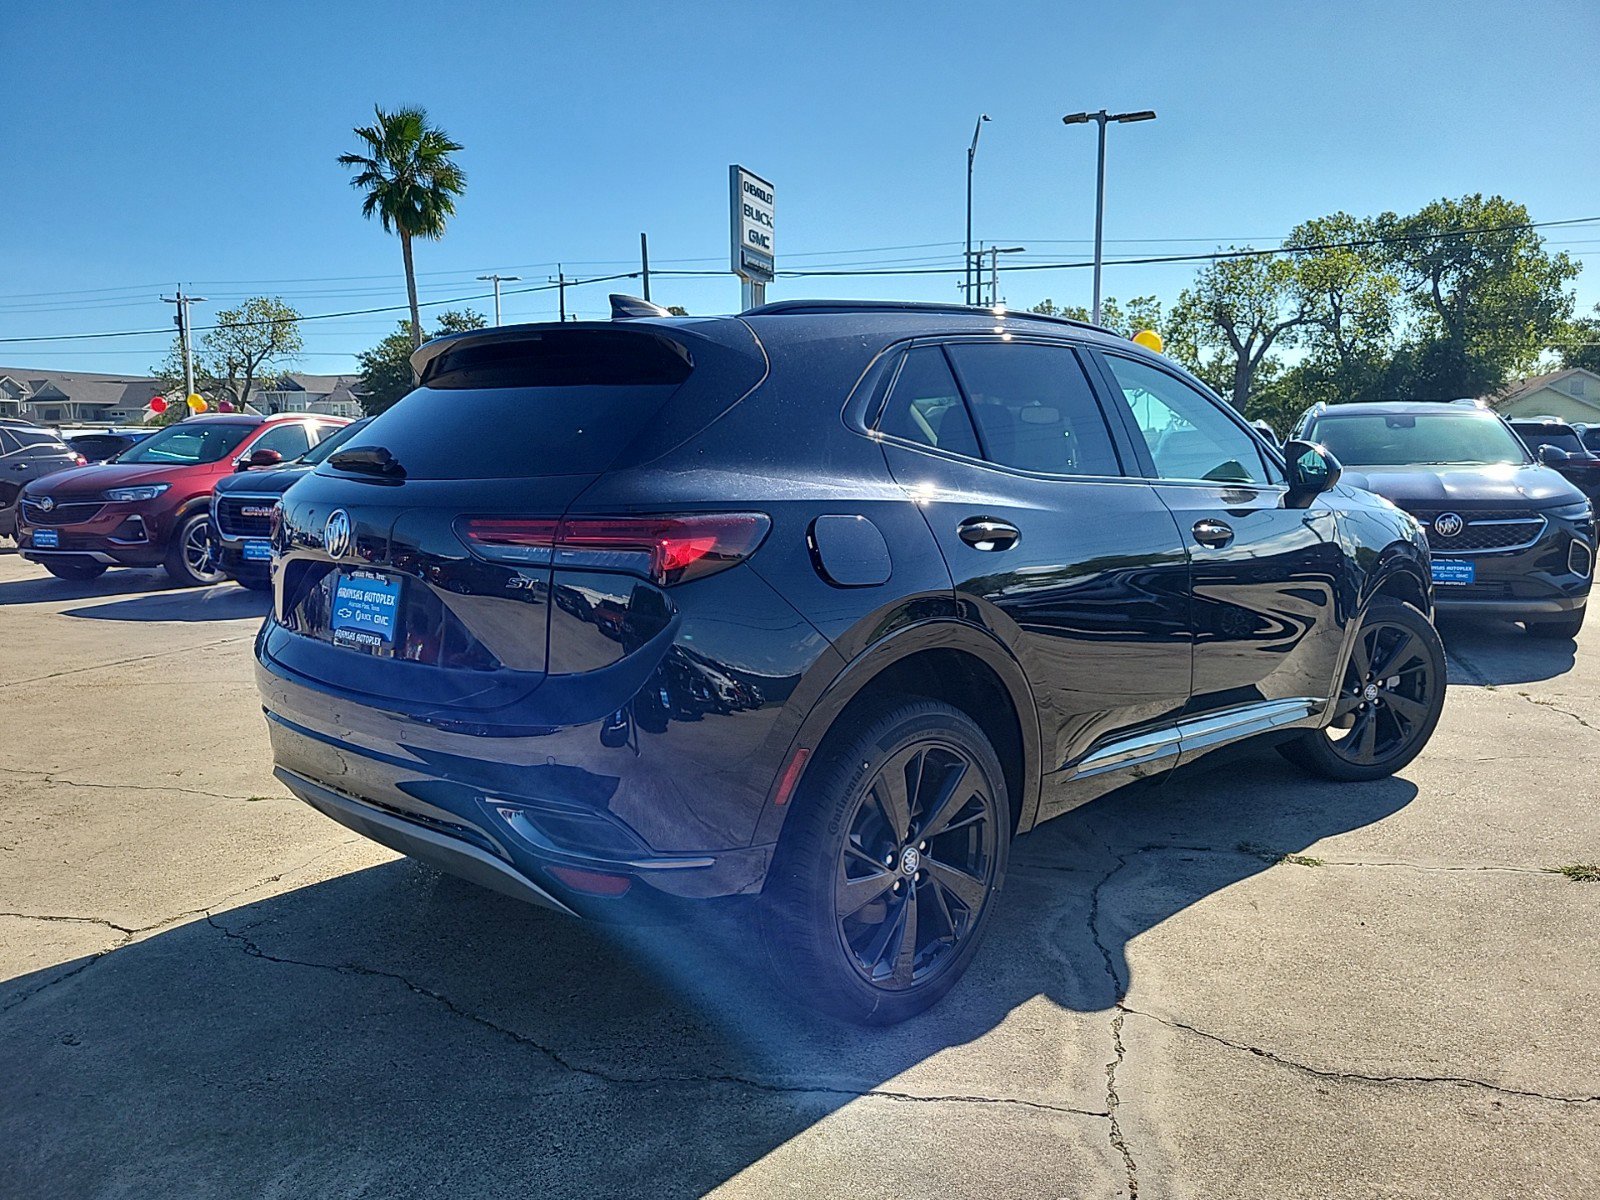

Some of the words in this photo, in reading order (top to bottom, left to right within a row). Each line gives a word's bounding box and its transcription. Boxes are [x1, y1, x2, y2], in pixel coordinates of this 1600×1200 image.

[743, 203, 774, 229] BUICK
[748, 229, 770, 250] GMC
[241, 506, 272, 517] GM
[505, 577, 540, 590] ST
[337, 587, 364, 601] ARANSAS
[363, 591, 396, 607] AUTOPLEX
[373, 614, 389, 626] GMC
[334, 629, 357, 641] ARANSAS
[356, 633, 382, 647] AUTOPLEX
[828, 765, 866, 835] Continental
